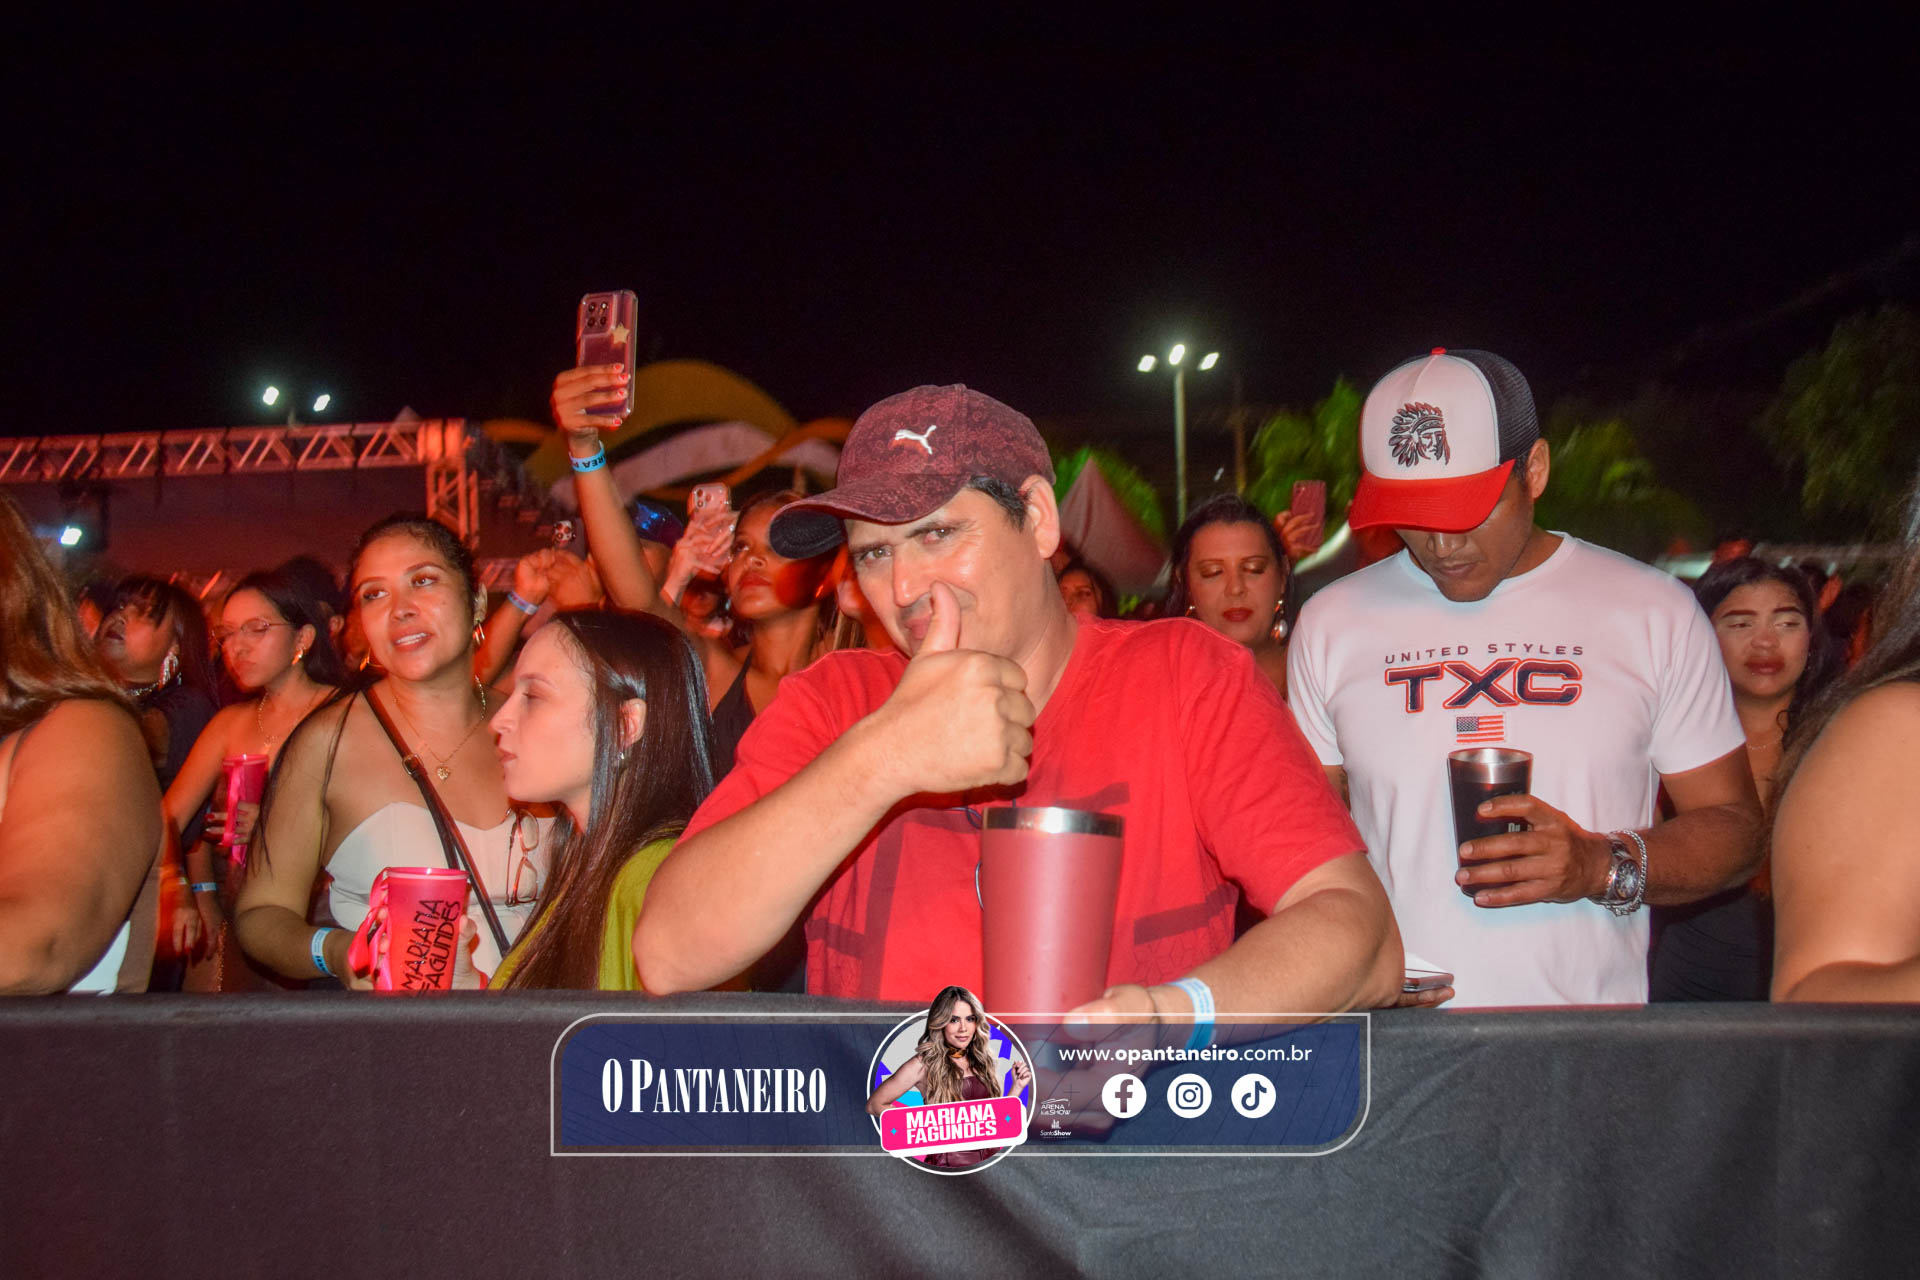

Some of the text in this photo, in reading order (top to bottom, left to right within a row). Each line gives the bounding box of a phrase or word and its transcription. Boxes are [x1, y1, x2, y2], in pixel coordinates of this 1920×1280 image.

[1385, 643, 1584, 664] UNITED STYLES
[1385, 657, 1583, 713] TXC
[400, 899, 445, 991] MARIANA
